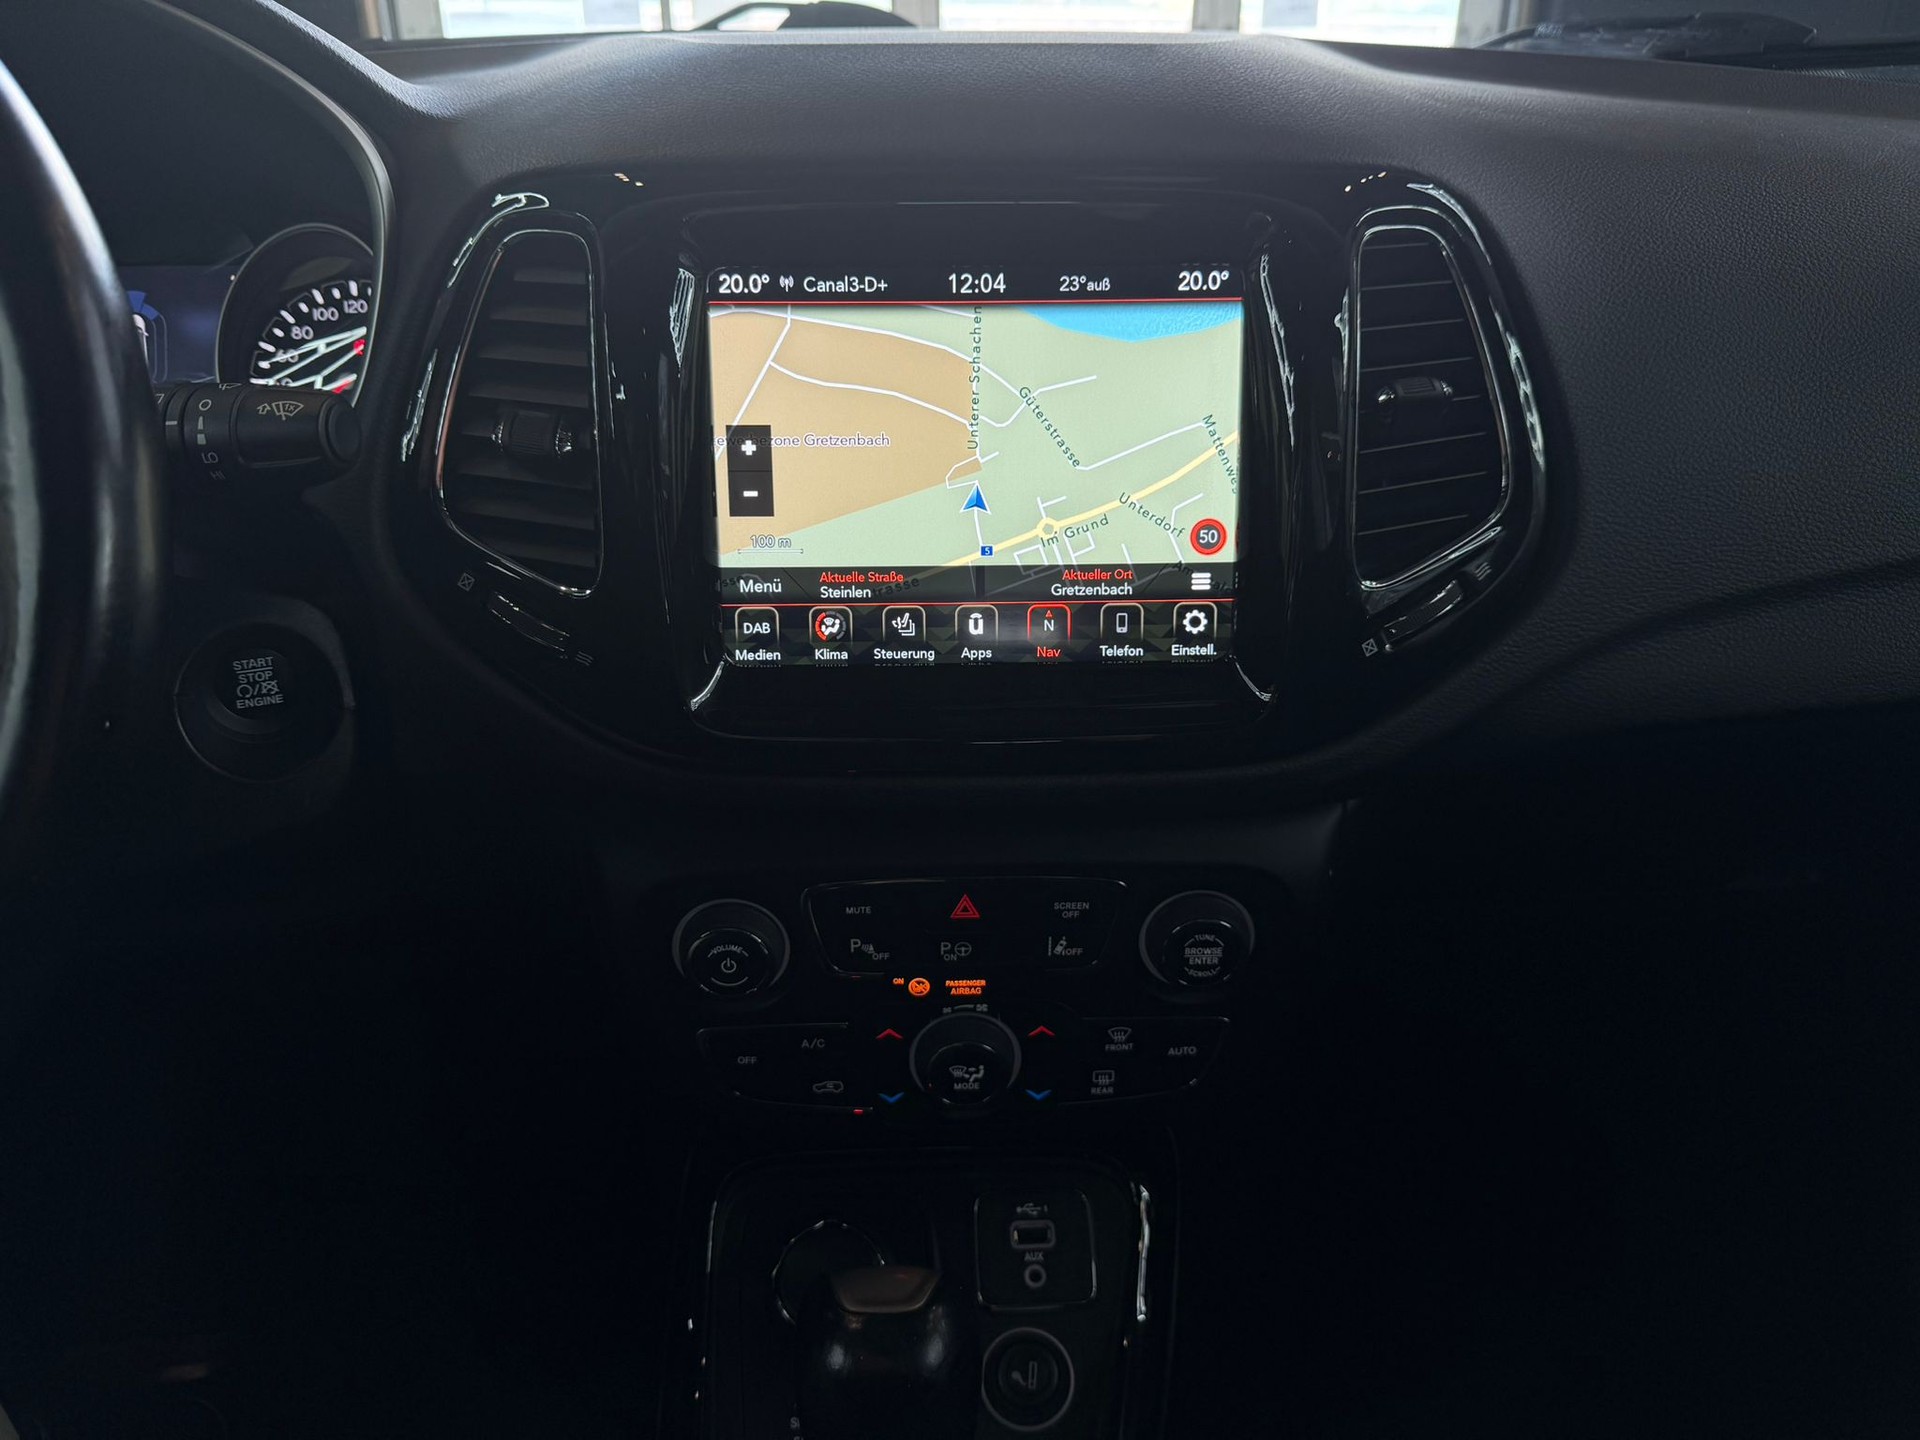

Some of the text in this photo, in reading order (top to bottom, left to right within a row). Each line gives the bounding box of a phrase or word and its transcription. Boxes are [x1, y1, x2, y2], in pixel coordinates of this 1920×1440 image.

[803, 275, 889, 293] Canal3-D+
[947, 272, 1007, 294] 12:04
[343, 300, 369, 315] 120
[312, 307, 340, 322] 100
[290, 325, 315, 340] 80
[967, 305, 983, 450] Unterer Schachen
[1019, 386, 1081, 468] Güterstrasse
[804, 433, 891, 447] Gretzenbach
[1118, 492, 1186, 538] Unterdorf
[1040, 513, 1110, 548] Im Grund
[1199, 529, 1218, 544] 50
[750, 535, 792, 549] 100 m
[819, 571, 904, 583] Aktuelle Straße
[1062, 568, 1133, 581] Aktueller Ort
[739, 578, 783, 593] Menü
[1051, 582, 1133, 596] Gretzenbach
[820, 586, 871, 599] Steinlen
[743, 621, 771, 635] DAB
[1043, 619, 1055, 632] N
[735, 650, 782, 661] Medien
[815, 649, 849, 661] Klima
[873, 648, 936, 662] Steuerung
[961, 647, 993, 661] Apps
[1036, 646, 1061, 658] Nav
[1099, 645, 1144, 657] Telefon
[1171, 644, 1218, 656] Einstell.
[232, 656, 274, 671] START
[238, 671, 273, 684] STOP
[236, 694, 284, 709] ENGINE
[845, 906, 873, 915] MUTE
[1053, 901, 1090, 911] SCREEN
[1062, 910, 1080, 919] OFF
[871, 952, 891, 961] OFF
[1183, 946, 1223, 955] BROWSE
[943, 953, 958, 962] ON
[1188, 956, 1219, 965] ENTER
[892, 977, 905, 985] ON
[945, 979, 987, 987] PASSENGER
[950, 987, 983, 996] AIRBAG
[801, 1038, 826, 1048] A/C
[1104, 1042, 1134, 1052] FRONT
[1167, 1046, 1198, 1057] AUTO
[737, 1055, 758, 1065] OFF
[953, 1081, 981, 1090] MODE
[1091, 1085, 1115, 1095] REAR
[1024, 1251, 1045, 1262] AUX
